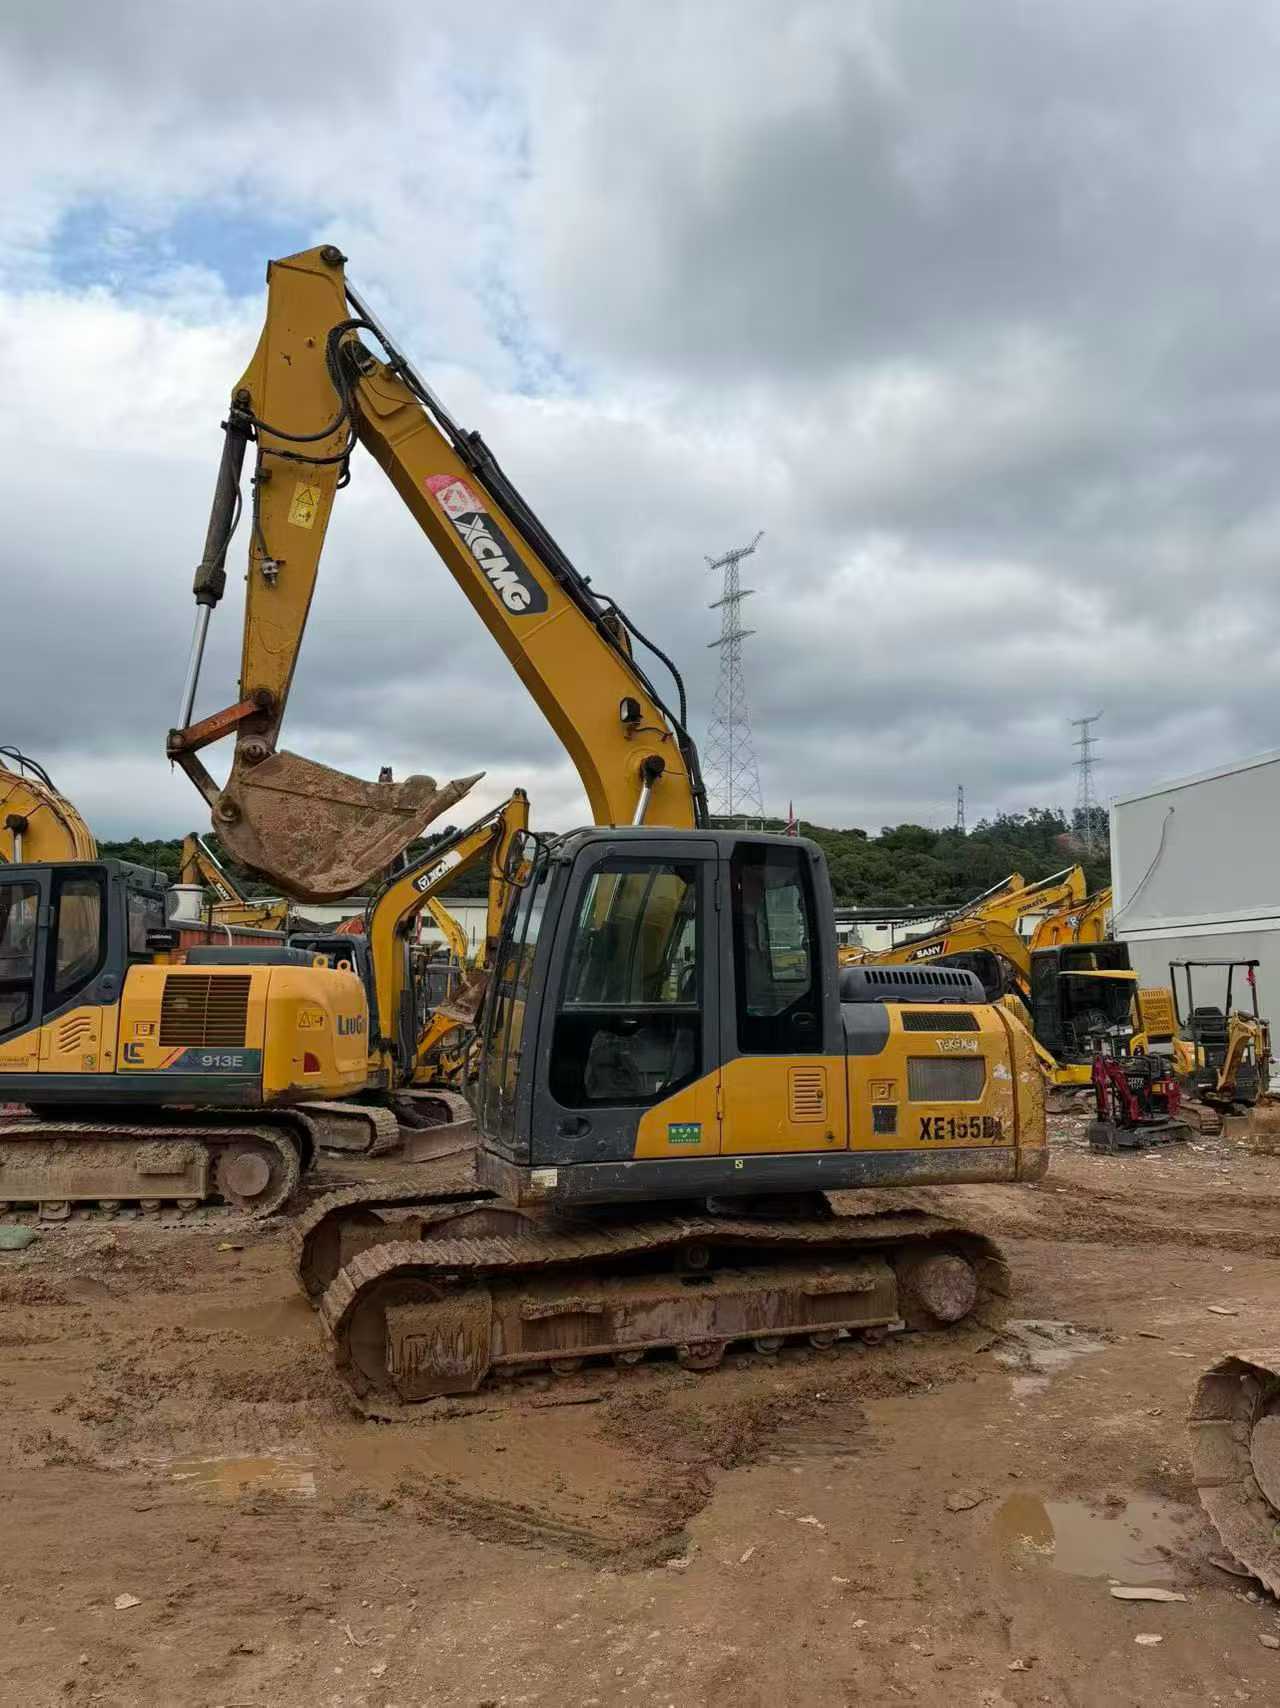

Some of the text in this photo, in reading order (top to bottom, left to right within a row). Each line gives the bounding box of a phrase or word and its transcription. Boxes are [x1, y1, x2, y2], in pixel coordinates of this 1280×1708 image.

[453, 514, 531, 611] XCMG
[916, 944, 940, 959] SANY
[201, 1055, 243, 1067] 913E
